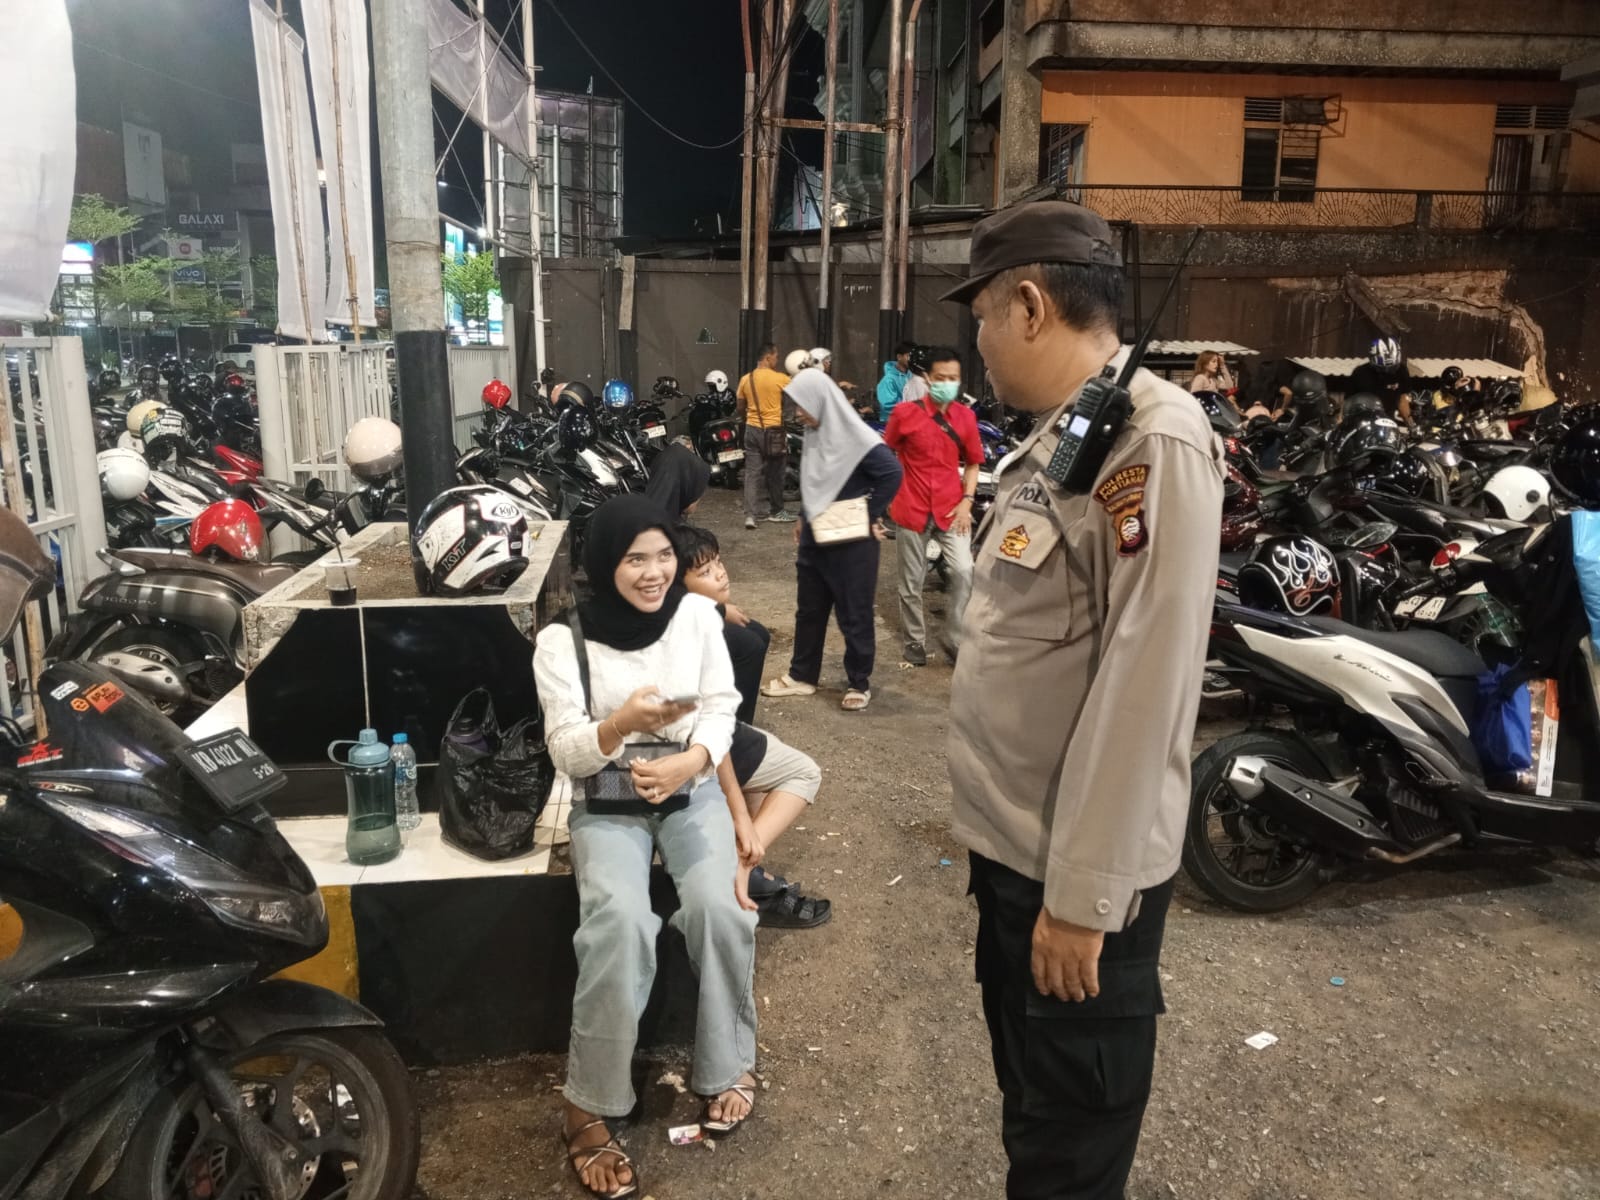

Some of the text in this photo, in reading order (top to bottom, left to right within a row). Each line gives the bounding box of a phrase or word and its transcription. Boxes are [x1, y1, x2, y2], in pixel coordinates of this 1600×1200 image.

[178, 214, 224, 225] GALAXI
[1099, 466, 1146, 498] POLRESTA
[442, 538, 466, 570] KYT
[191, 750, 219, 774] KB
[208, 743, 242, 767] 4022
